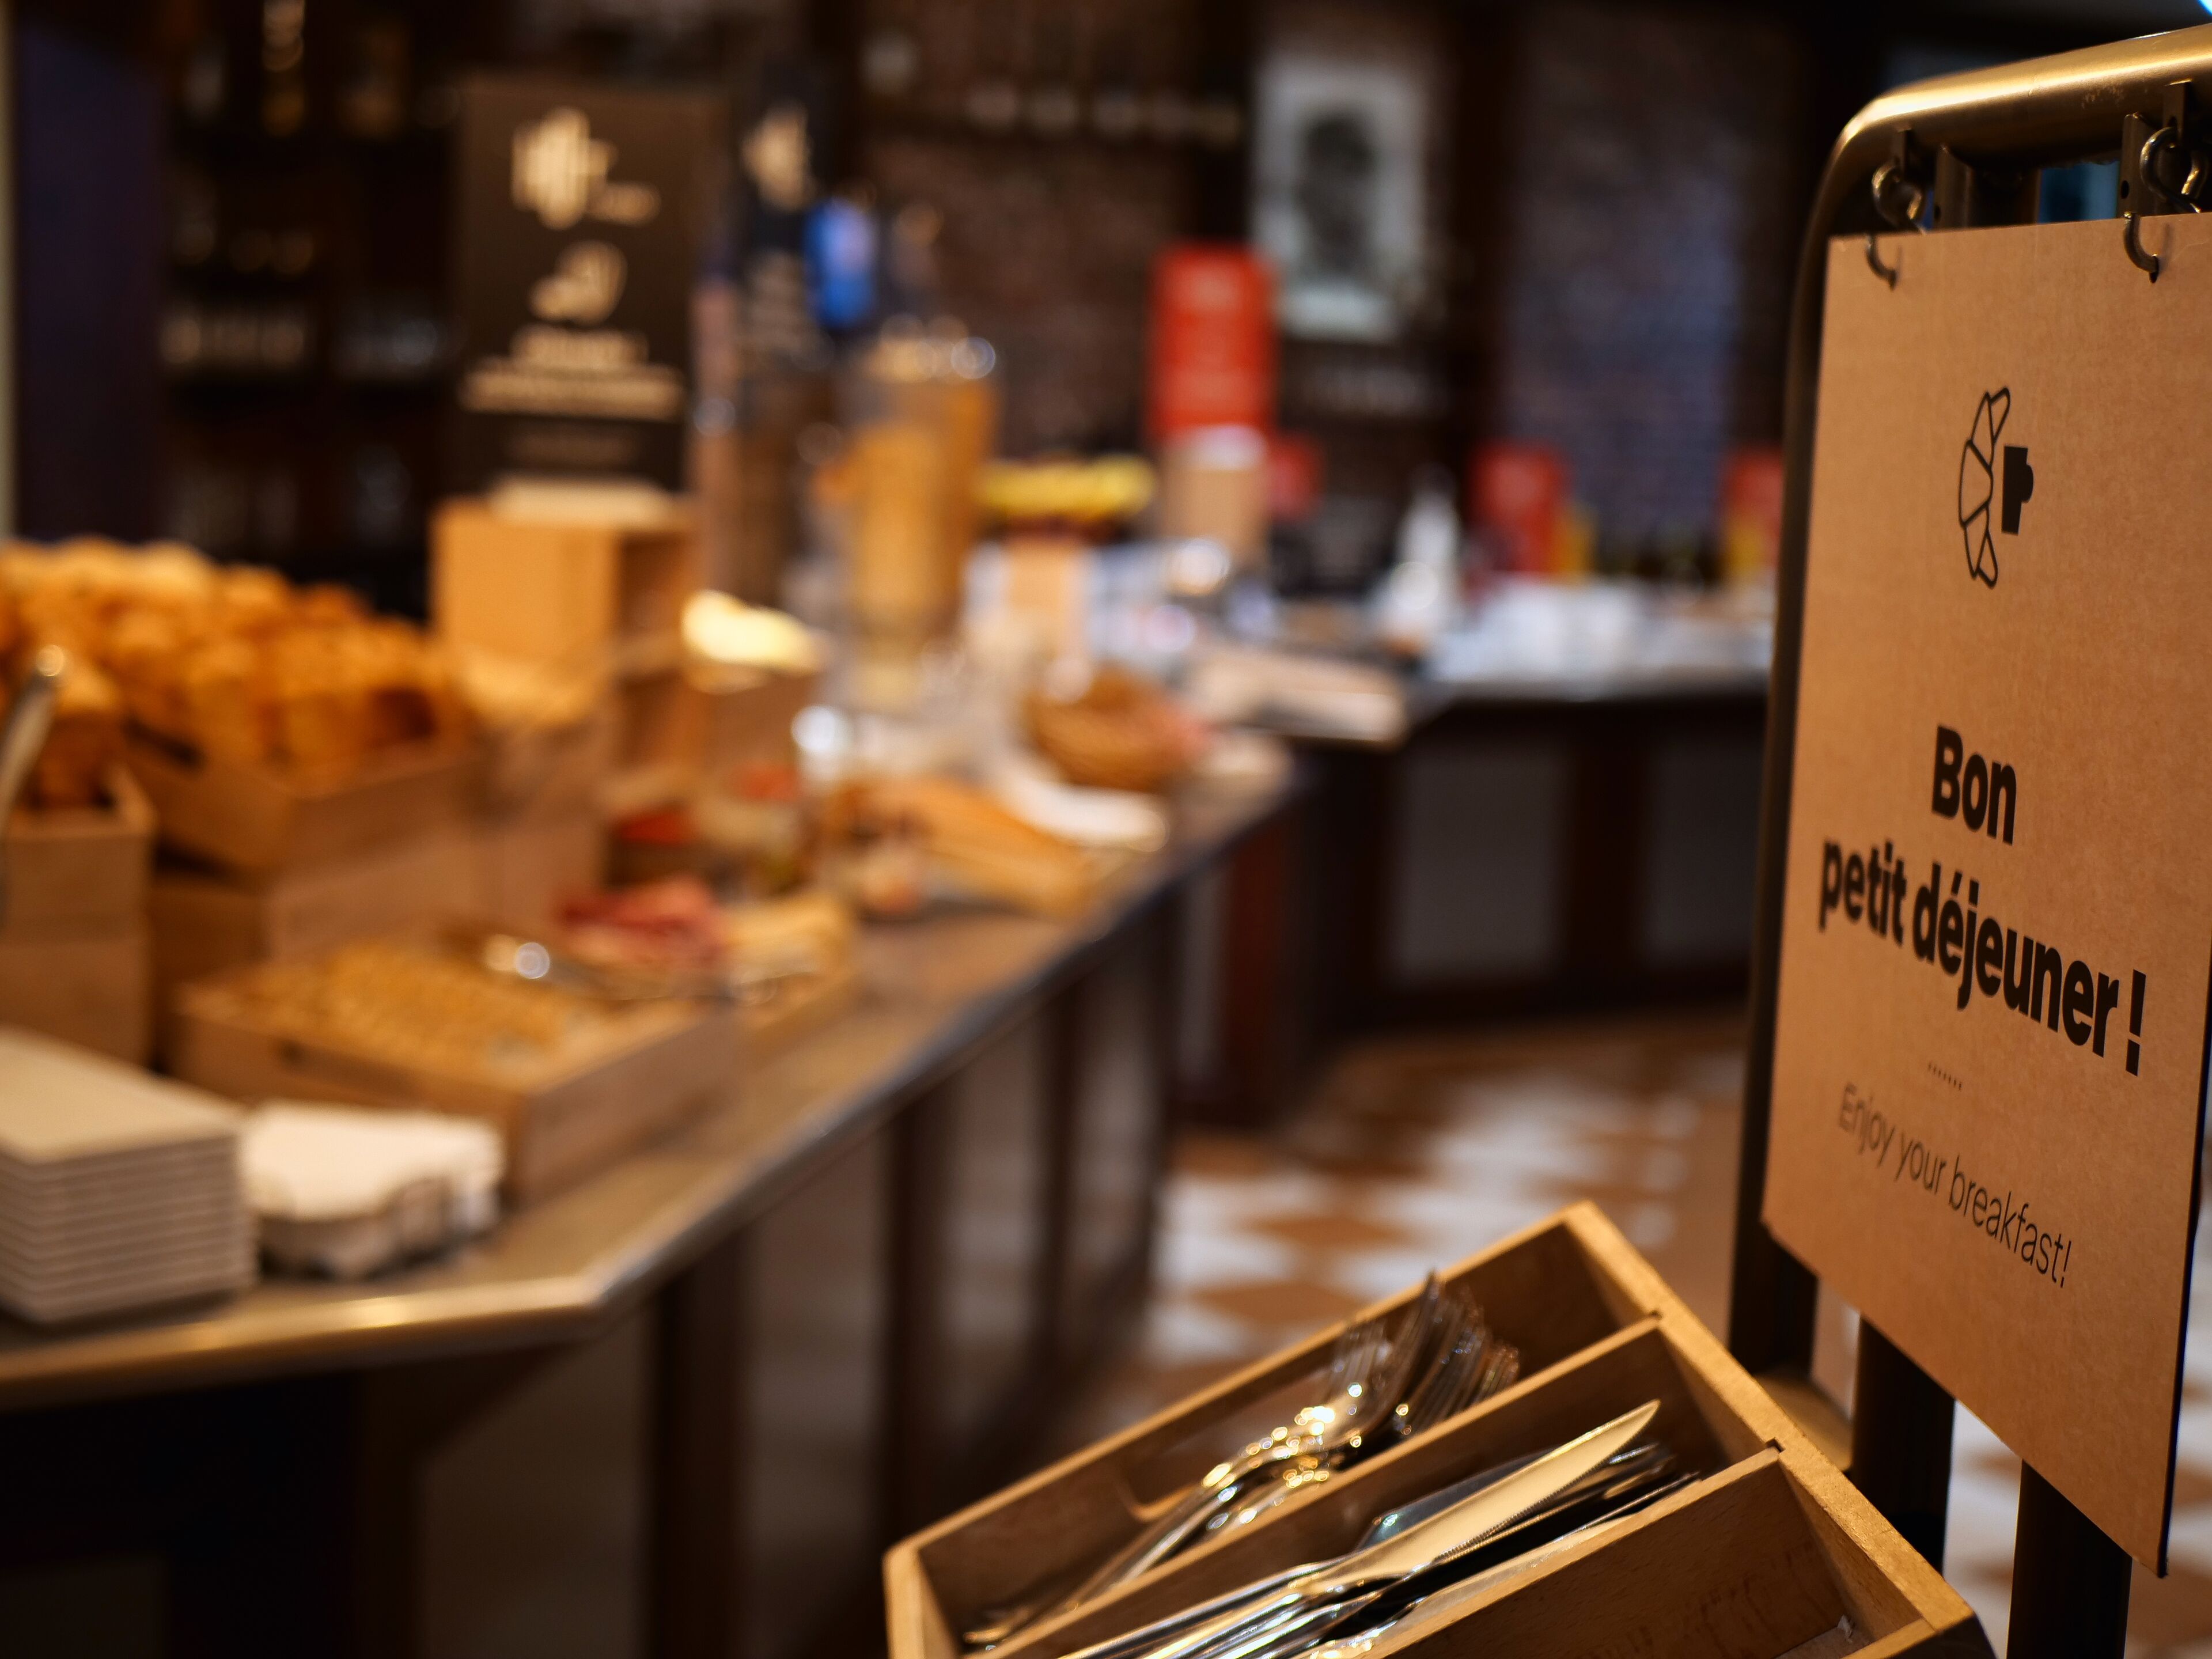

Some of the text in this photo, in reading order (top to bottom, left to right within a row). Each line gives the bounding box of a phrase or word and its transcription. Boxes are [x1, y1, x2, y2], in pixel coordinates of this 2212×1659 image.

[1931, 725, 2017, 846] Bon
[1819, 838, 1907, 948] petit
[1839, 1083, 2073, 1288] Enjoy your breakfast!
